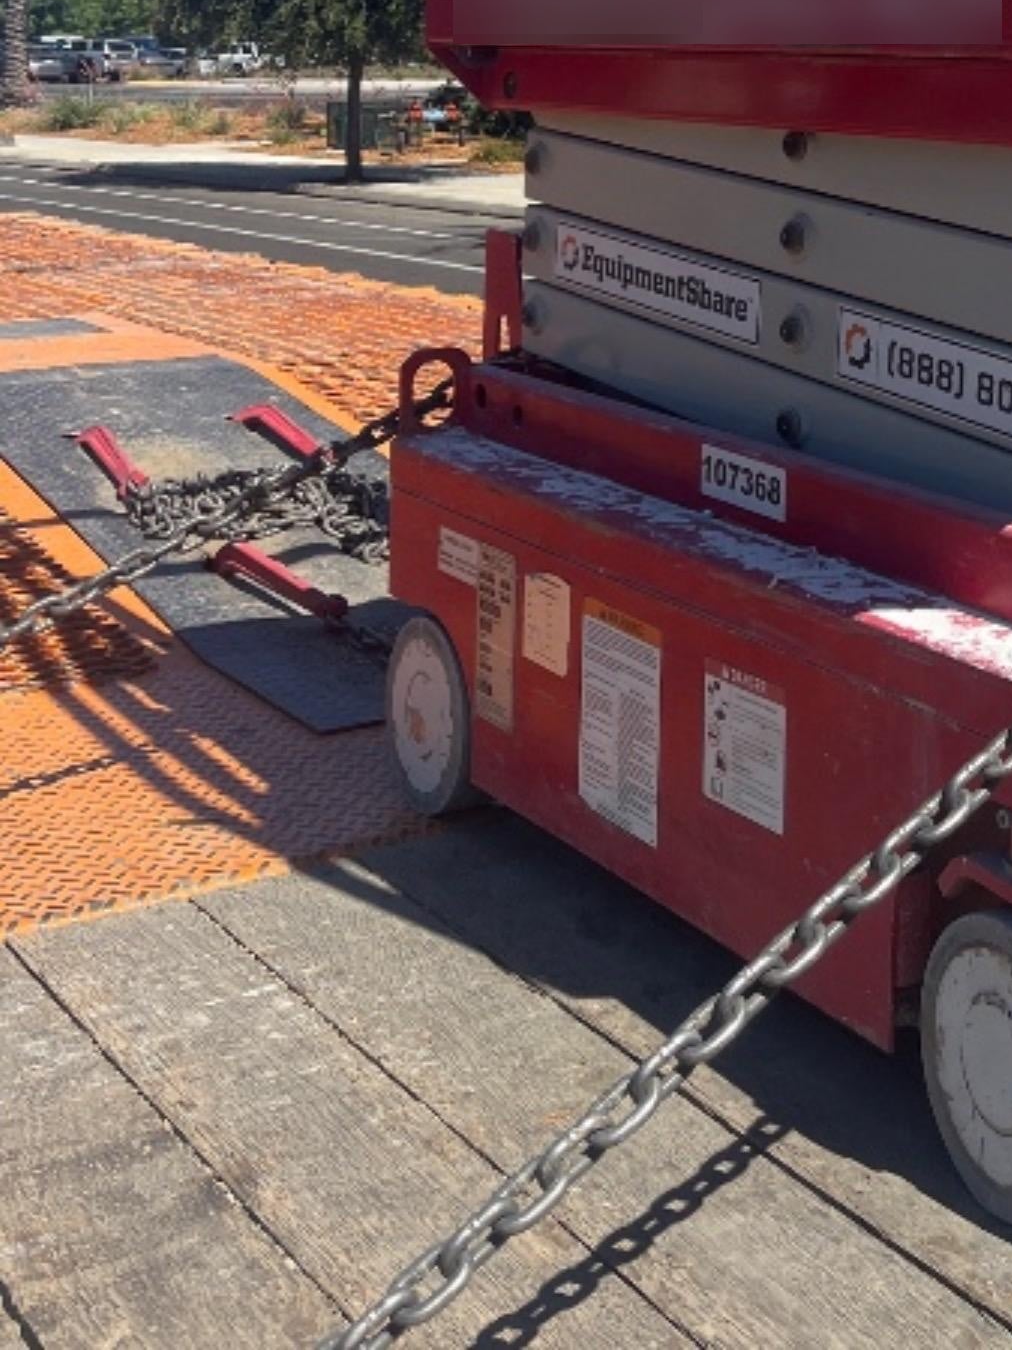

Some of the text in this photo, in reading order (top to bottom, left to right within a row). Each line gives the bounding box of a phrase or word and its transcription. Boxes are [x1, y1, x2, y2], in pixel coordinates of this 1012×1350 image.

[580, 242, 749, 323] EquipmentShare
[886, 339, 965, 400] (888)
[703, 455, 781, 506] 107368
